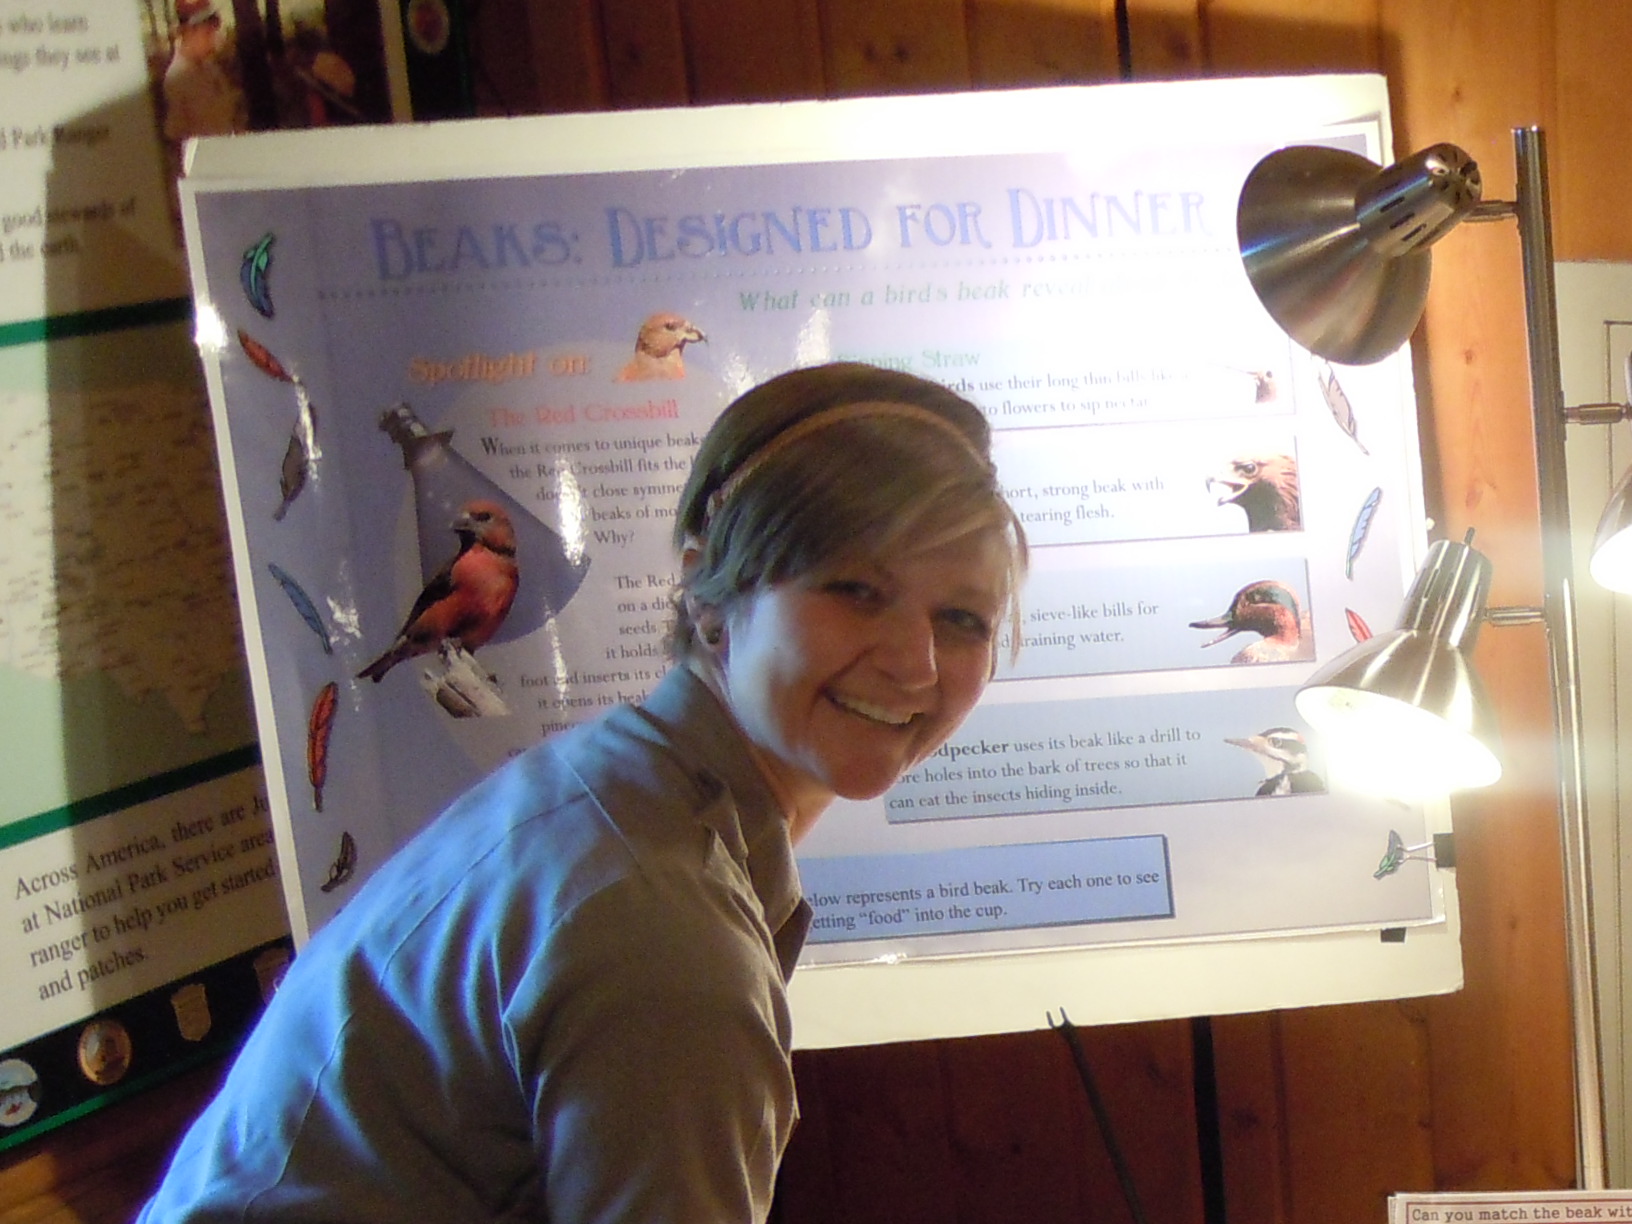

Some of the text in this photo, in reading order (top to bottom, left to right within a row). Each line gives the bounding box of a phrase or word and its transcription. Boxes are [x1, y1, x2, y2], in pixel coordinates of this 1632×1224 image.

[35, 43, 71, 71] they
[895, 200, 992, 250] FOR
[1006, 187, 1214, 249] DINNER
[738, 290, 799, 313] What
[809, 293, 851, 307] can
[860, 291, 874, 306] a
[957, 279, 1010, 302] beak
[409, 350, 590, 387] Spotlight on
[922, 350, 981, 369] Straw
[979, 380, 1003, 393] use
[1007, 374, 1042, 390] their
[1047, 373, 1080, 394] long
[490, 398, 680, 428] The Red Crossbill
[1002, 400, 1057, 416] flowers
[1060, 399, 1077, 412] to
[480, 436, 662, 456] When it comes to unique
[509, 464, 530, 479] the
[638, 457, 660, 472] fits
[663, 456, 686, 471] the
[593, 482, 629, 499] close
[1042, 476, 1165, 500] strong beak with
[591, 504, 650, 522] beaks of
[1020, 504, 1115, 527] tearing flesh.
[593, 530, 635, 549] Why?
[614, 573, 676, 590] The Red
[617, 601, 648, 613] on a
[1030, 604, 1099, 623] sieve-like
[1102, 601, 1134, 618] bills
[1137, 600, 1160, 616] for
[605, 643, 658, 660] it holds
[1020, 633, 1076, 651] raining
[1080, 631, 1125, 645] water.
[520, 672, 549, 688] foot
[582, 670, 630, 685] inserts
[633, 668, 652, 681] its
[537, 692, 614, 710] it its
[1013, 741, 1044, 753] uses
[1048, 736, 1066, 751] its
[1069, 732, 1104, 750] beak
[1107, 730, 1134, 747] like
[1138, 735, 1146, 745] a
[1150, 726, 1181, 744] drill
[1186, 729, 1201, 741] to
[924, 752, 1188, 783] holes into the bark of trees so that it
[889, 780, 1123, 810] can eat the insects hiding inside.
[13, 863, 79, 901] Across
[85, 836, 167, 875] America,
[170, 815, 214, 844] there
[220, 804, 246, 827] are
[20, 842, 235, 935] at National Park Service
[846, 872, 1160, 909] represents a bird beak. Try each one to see
[28, 856, 277, 969] ranger to help you get started
[915, 907, 945, 922] into
[948, 904, 972, 919] the
[975, 907, 1008, 920] cup.
[37, 944, 150, 1002] and patches.
[1411, 1208, 1440, 1222] Can
[1444, 1210, 1474, 1223] you
[1478, 1207, 1529, 1221] match
[1532, 1206, 1561, 1220] the
[1565, 1206, 1603, 1219] beak
